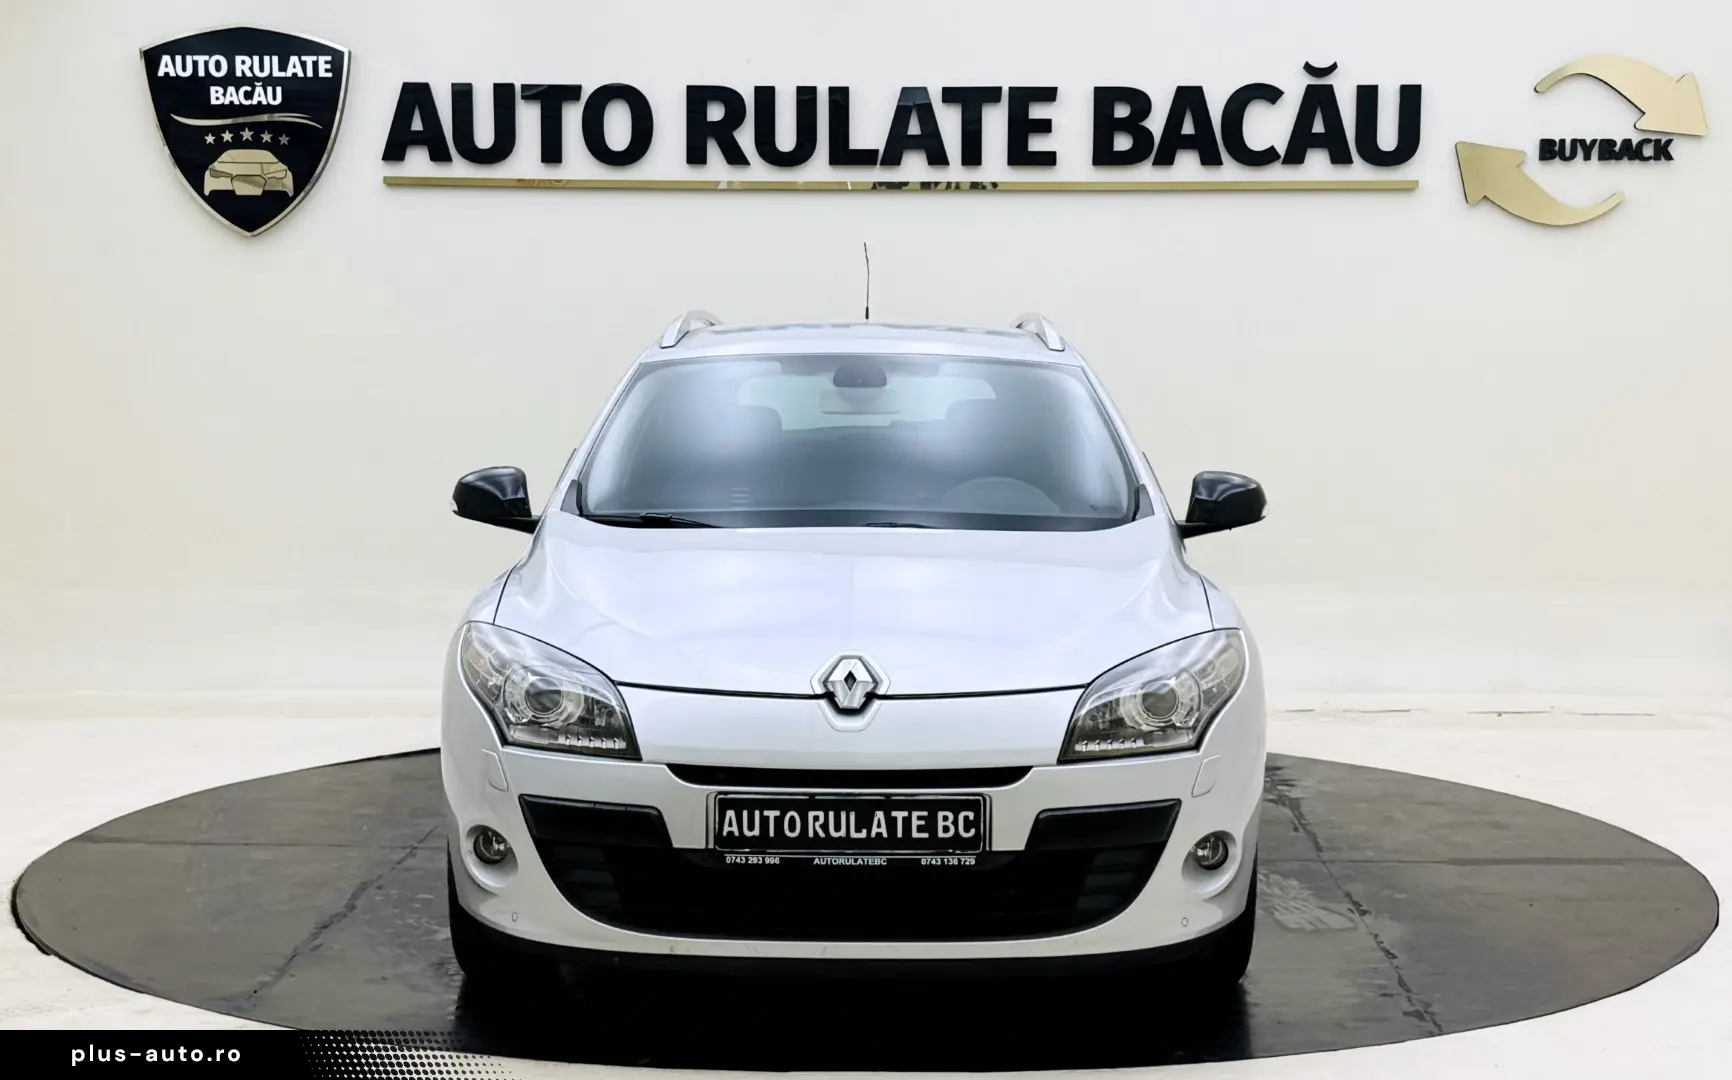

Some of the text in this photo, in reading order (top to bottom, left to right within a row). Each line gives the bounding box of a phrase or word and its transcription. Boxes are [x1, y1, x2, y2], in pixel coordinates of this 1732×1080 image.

[157, 54, 333, 78] AUTO RULATE
[209, 81, 283, 106] BACĂU
[381, 61, 1422, 169] AUTO RULATE BACĂU
[1538, 137, 1675, 162] BUYBACK
[722, 809, 976, 839] AUTO RULATE BC
[725, 856, 780, 865] 0743 293 996
[813, 857, 887, 866] AUTORULATEBC
[920, 857, 976, 866] 0743 136 729
